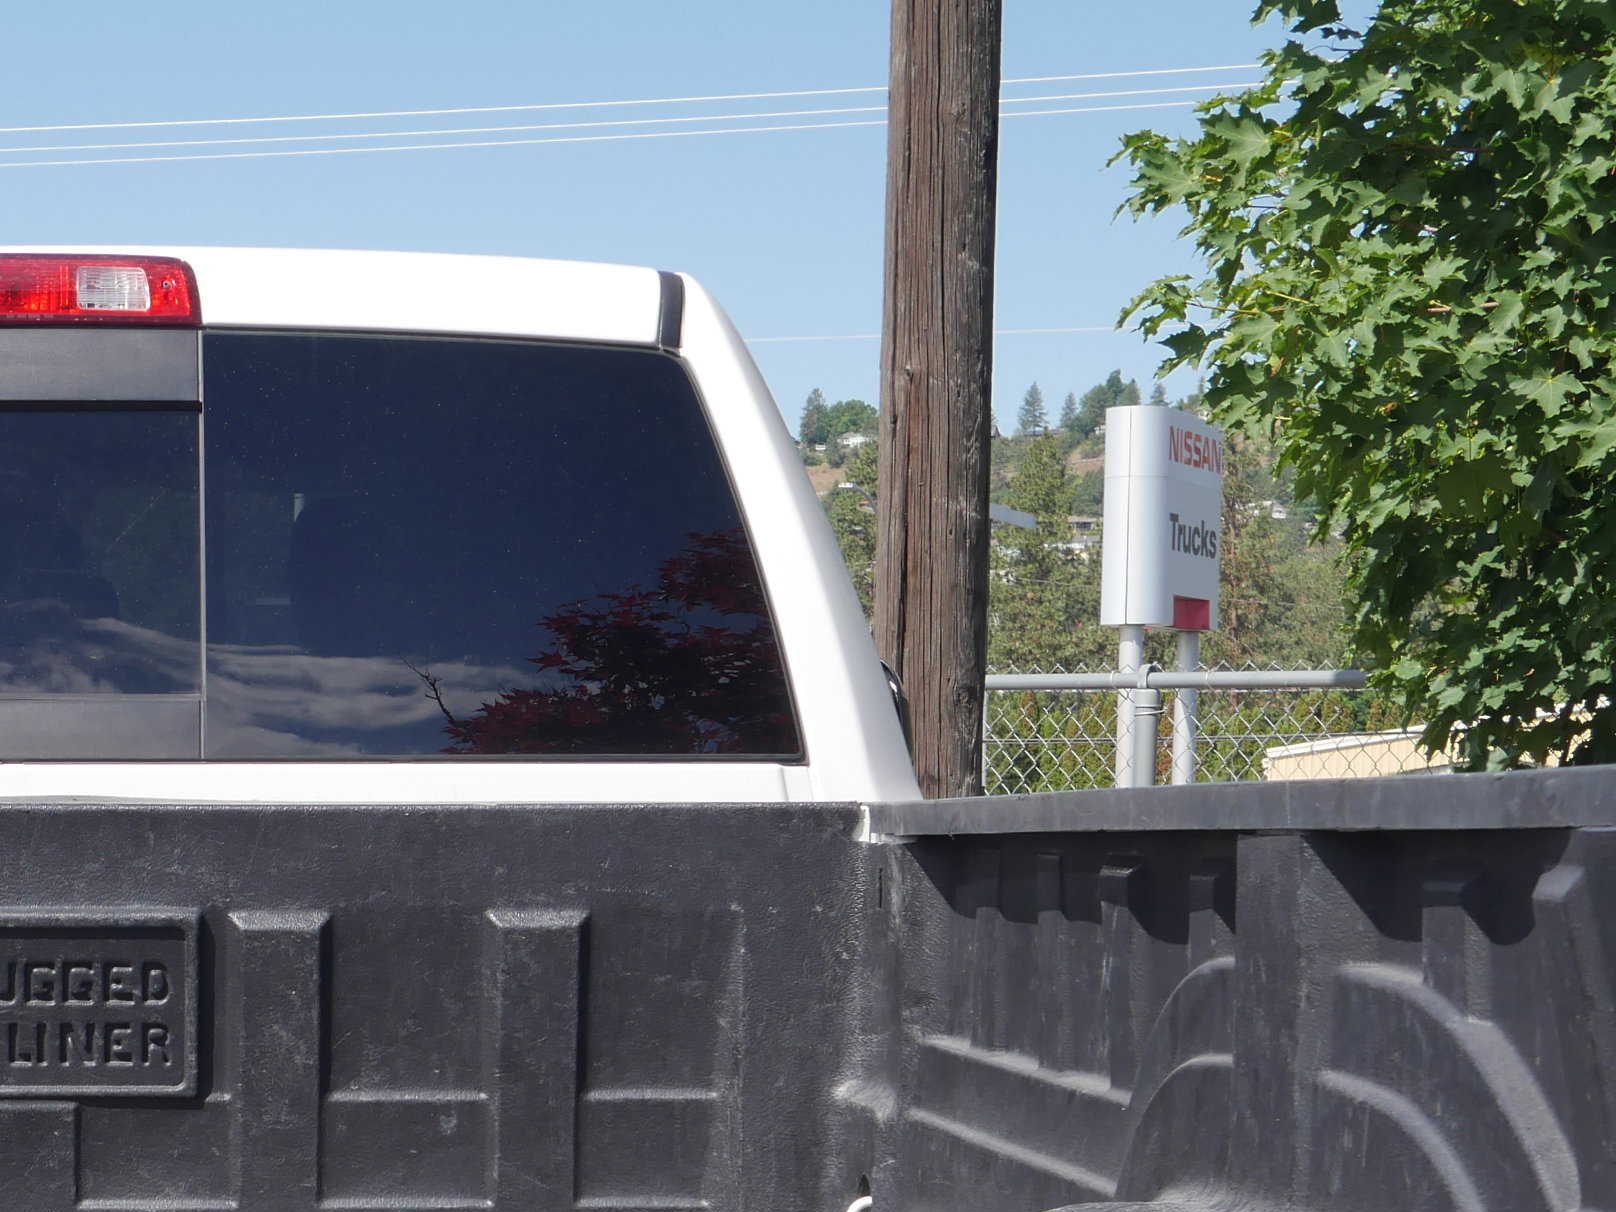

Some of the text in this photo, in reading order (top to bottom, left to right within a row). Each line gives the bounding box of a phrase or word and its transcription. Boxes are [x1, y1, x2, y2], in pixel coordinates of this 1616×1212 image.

[1169, 425, 1222, 474] NISSAN
[1169, 512, 1217, 559] Trucks
[6, 1021, 172, 1067] LINER
